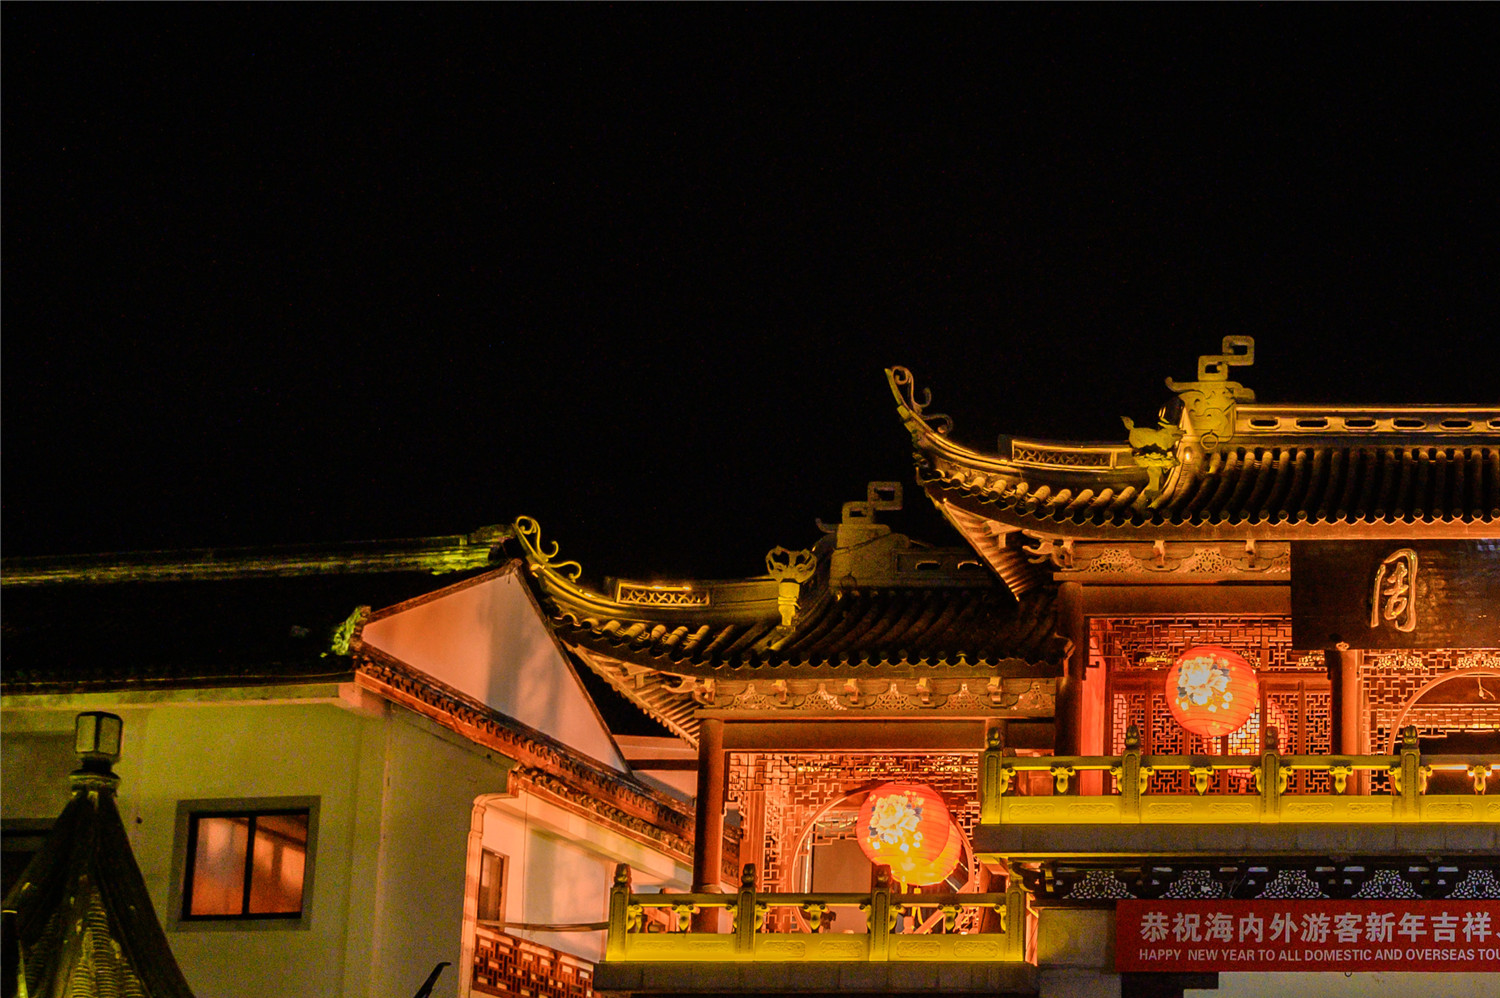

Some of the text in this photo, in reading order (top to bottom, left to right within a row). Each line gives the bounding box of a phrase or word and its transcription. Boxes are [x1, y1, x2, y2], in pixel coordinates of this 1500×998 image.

[1139, 949, 1181, 961] HAPPY
[1188, 949, 1218, 961] NEW
[1221, 949, 1256, 961] YEAR
[1258, 949, 1276, 961] TO
[1278, 949, 1302, 961] ALL
[1304, 949, 1372, 961] DOMESTIC
[1374, 949, 1403, 961] AND
[1406, 949, 1475, 961] OVERSEAS
